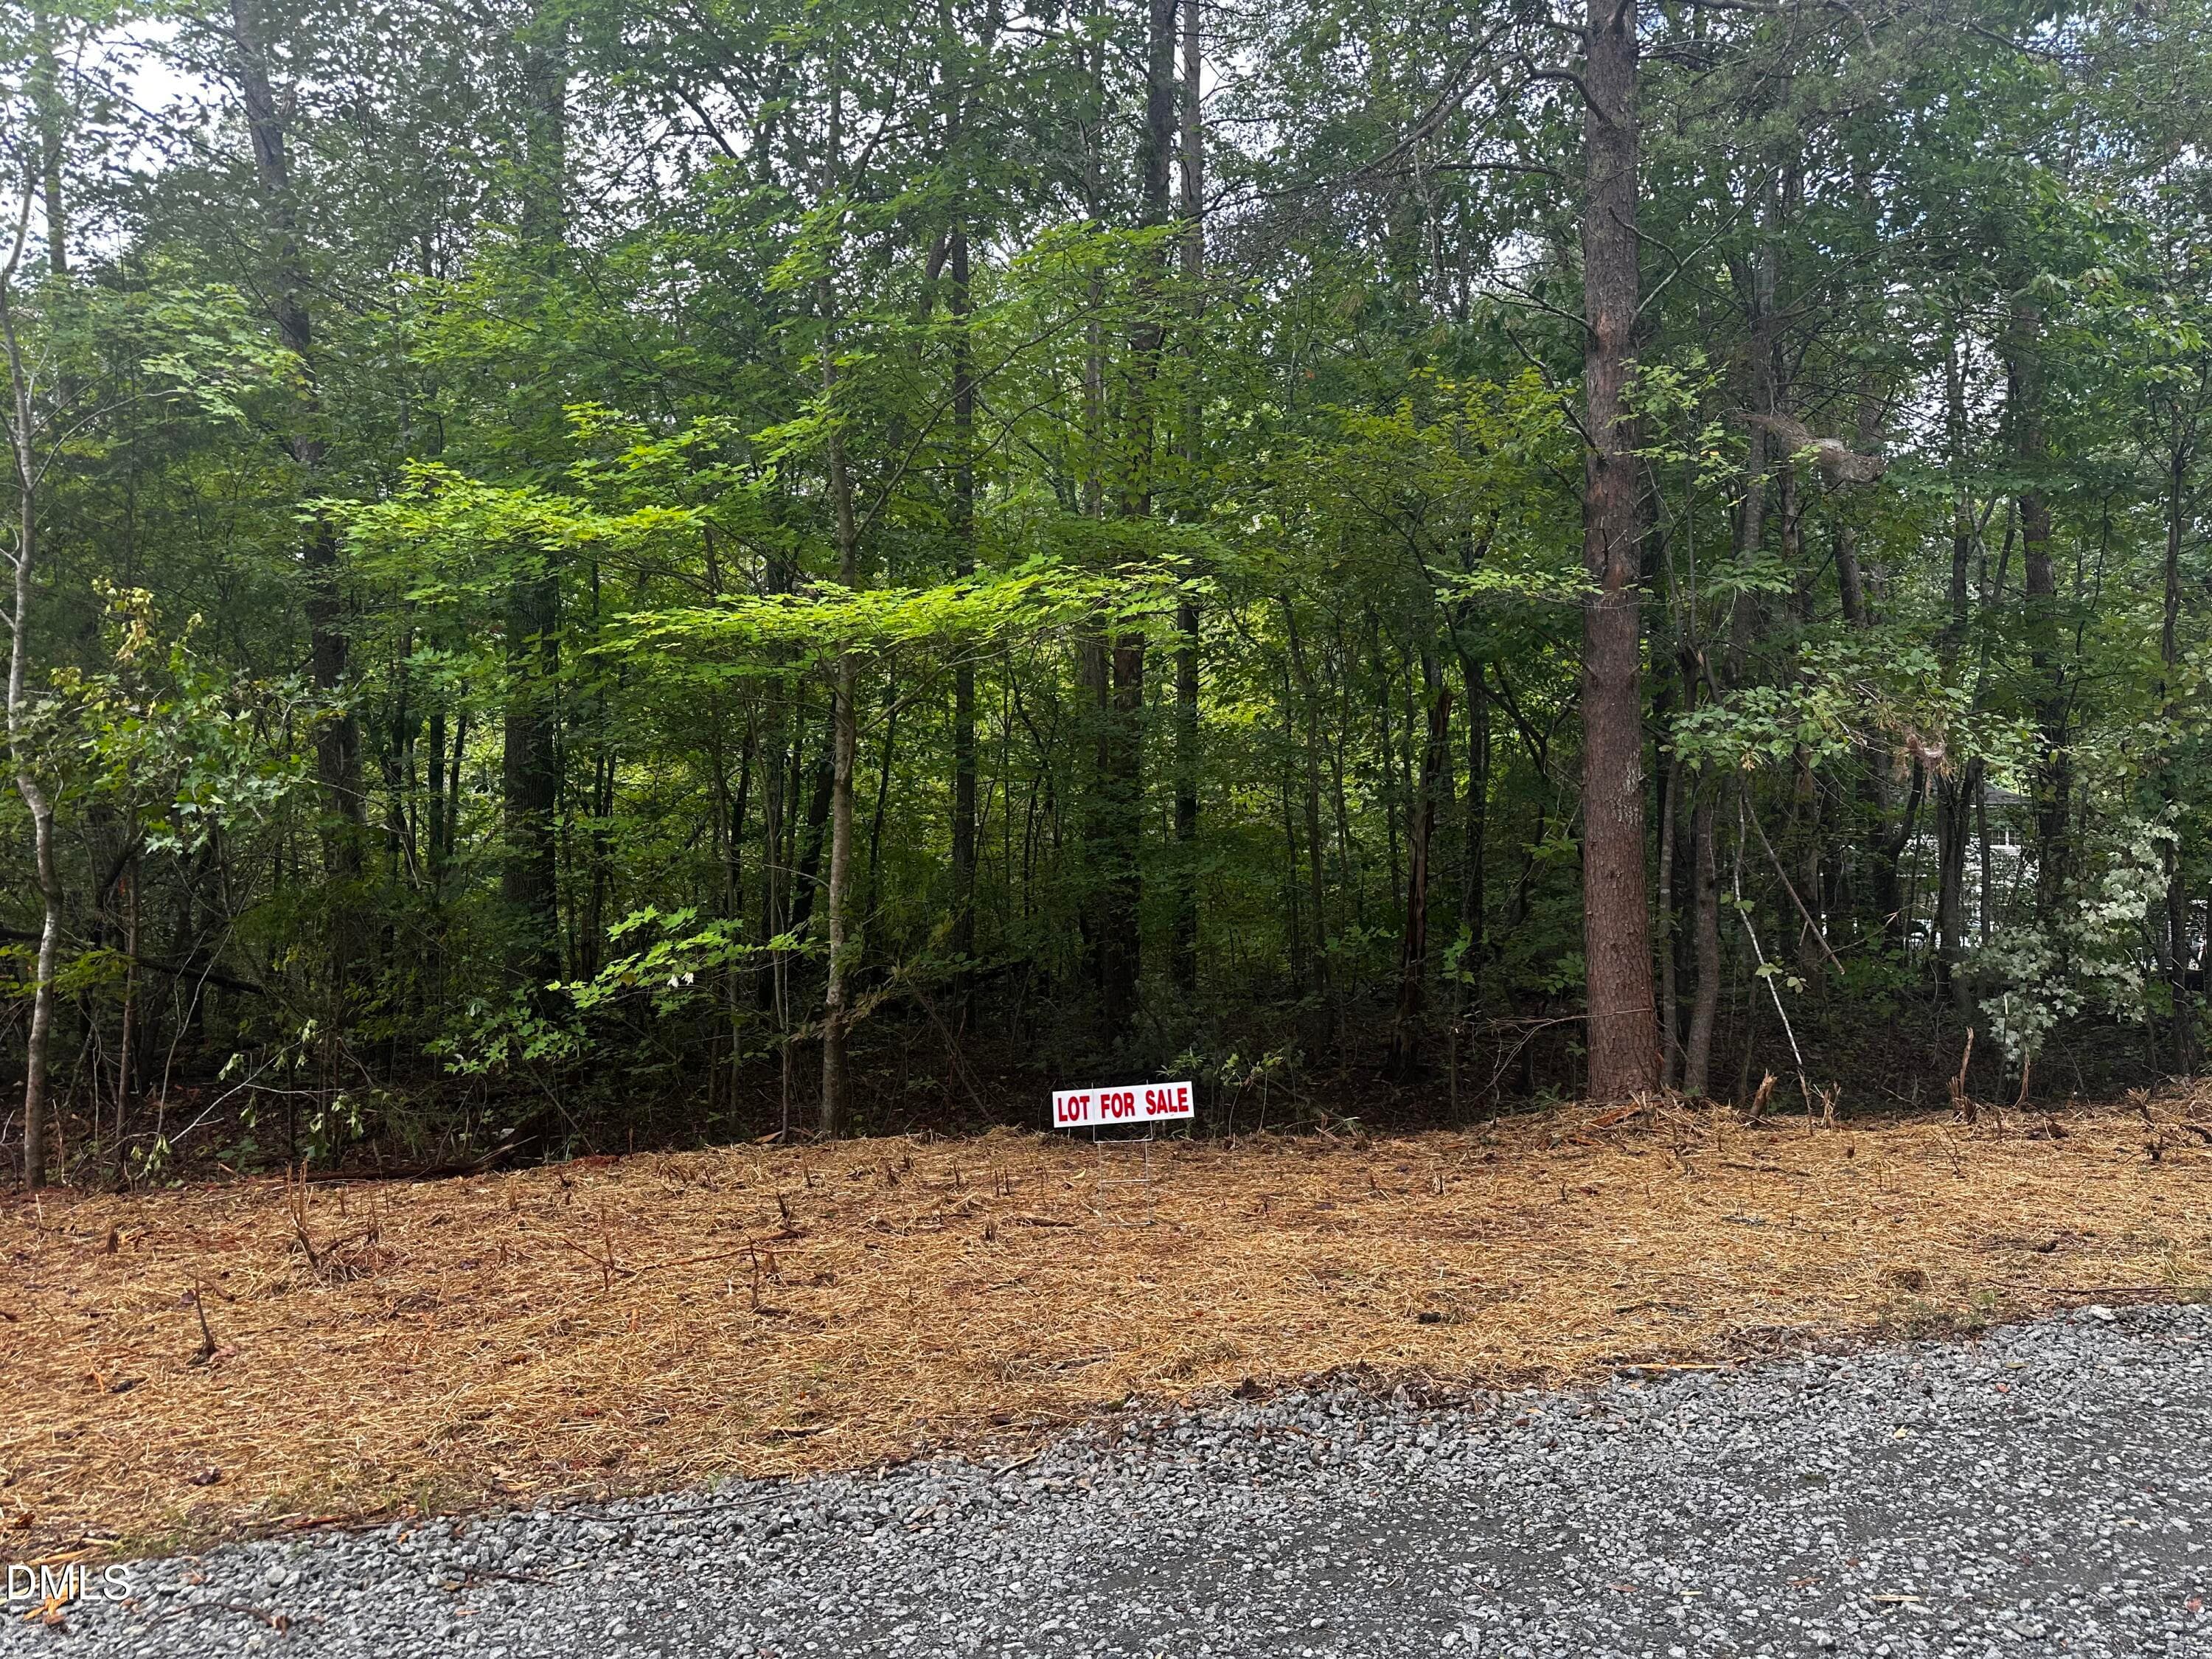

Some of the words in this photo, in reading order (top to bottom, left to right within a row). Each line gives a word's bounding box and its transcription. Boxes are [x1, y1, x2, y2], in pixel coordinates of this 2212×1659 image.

[1057, 1096, 1090, 1121] LOT
[1100, 1092, 1135, 1119] FOR
[1145, 1088, 1189, 1115] SALE
